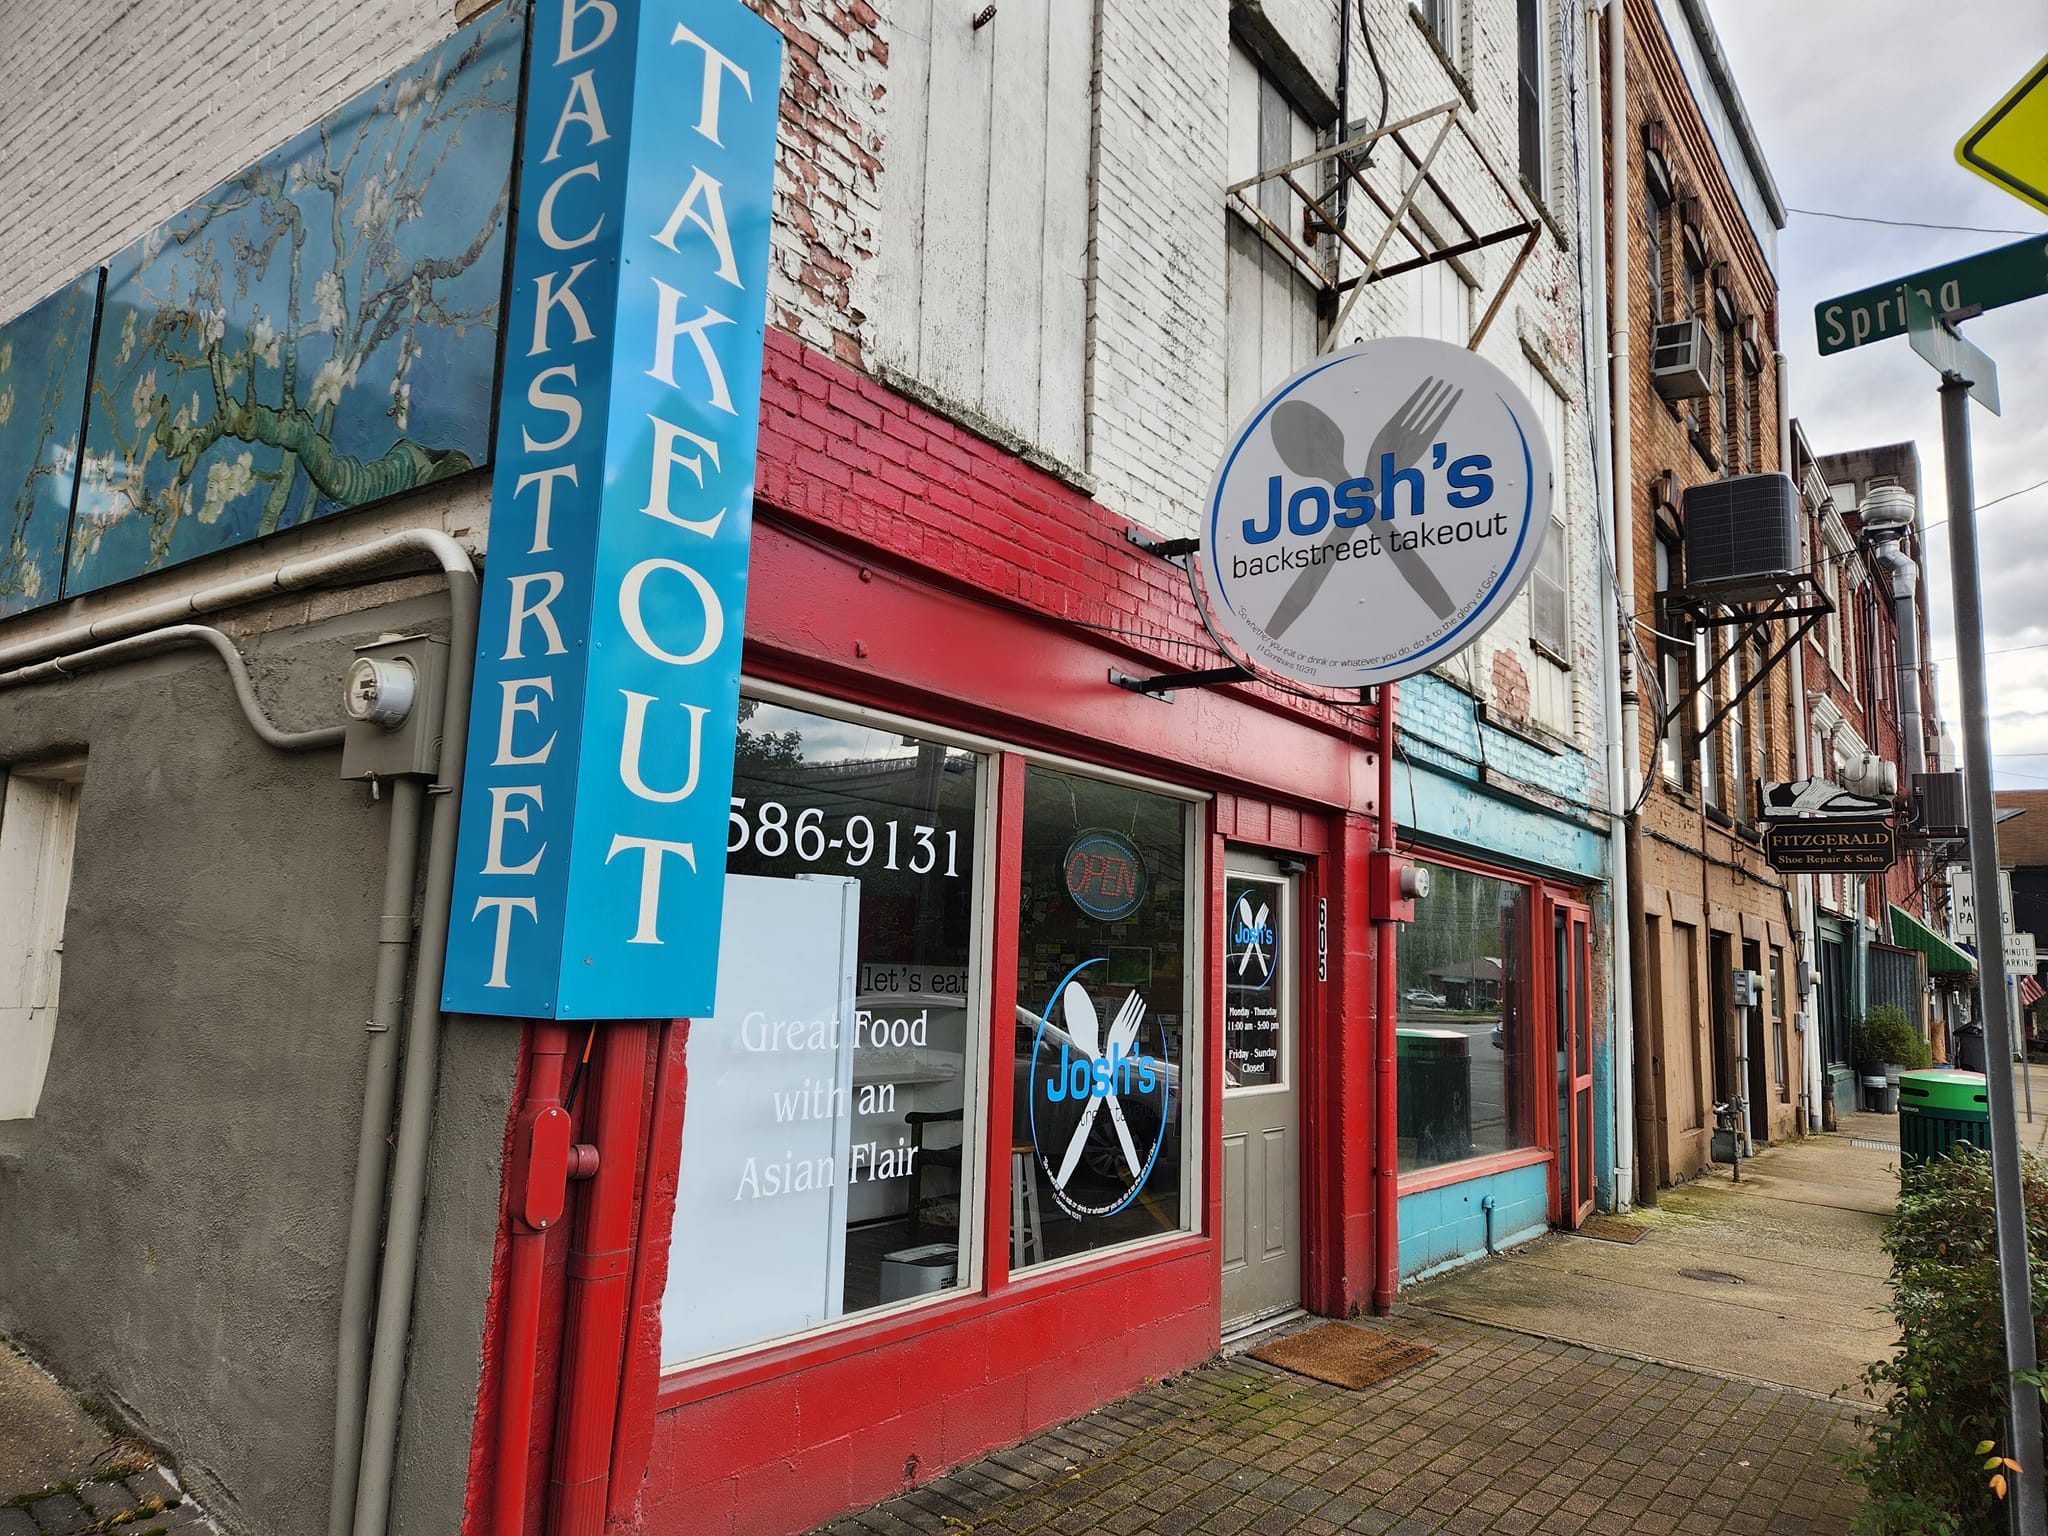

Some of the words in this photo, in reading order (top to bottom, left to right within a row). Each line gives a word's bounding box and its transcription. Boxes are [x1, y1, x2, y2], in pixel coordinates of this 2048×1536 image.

[605, 22, 753, 945] TAKEOUT
[1242, 442, 1494, 545] Josh's
[1233, 533, 1381, 580] backstreet
[1389, 513, 1508, 551] takeout
[1270, 640, 1283, 652] you
[1283, 647, 1297, 658] eat
[1341, 656, 1380, 667] whatever
[1381, 652, 1398, 664] you
[1413, 639, 1425, 650] do
[1432, 629, 1443, 638] to
[1442, 617, 1458, 631] the
[1456, 599, 1479, 620] glory
[728, 797, 959, 878] 586-9131
[1772, 833, 1889, 847] FITZGERALD
[1778, 855, 1804, 864] Shoe
[1806, 855, 1841, 865] Repair
[1843, 855, 1853, 863] &
[1856, 854, 1884, 863] Sales
[1067, 852, 1139, 899] OPEN
[1235, 921, 1273, 945] Josh's
[1318, 898, 1327, 981] 605
[2010, 938, 2021, 946] 10
[863, 966, 922, 993] let's
[931, 970, 968, 993] eat
[2005, 959, 2034, 968] ARKING
[740, 1010, 841, 1053] Great
[853, 1009, 927, 1049] Food
[1228, 1021, 1244, 1030] 11:00
[1257, 1021, 1270, 1030] 5:00
[1270, 1022, 1280, 1032] pm
[1229, 1007, 1250, 1018] Monday
[1253, 1007, 1277, 1018] Thursday
[1047, 1042, 1157, 1102] Josh's
[1229, 1049, 1249, 1060] Friday
[1254, 1048, 1277, 1059] Sunday
[1242, 1062, 1265, 1072] Closed
[773, 1077, 844, 1124] with
[858, 1082, 895, 1115] an
[734, 1151, 834, 1201] Asian
[849, 1138, 919, 1184] Flair
